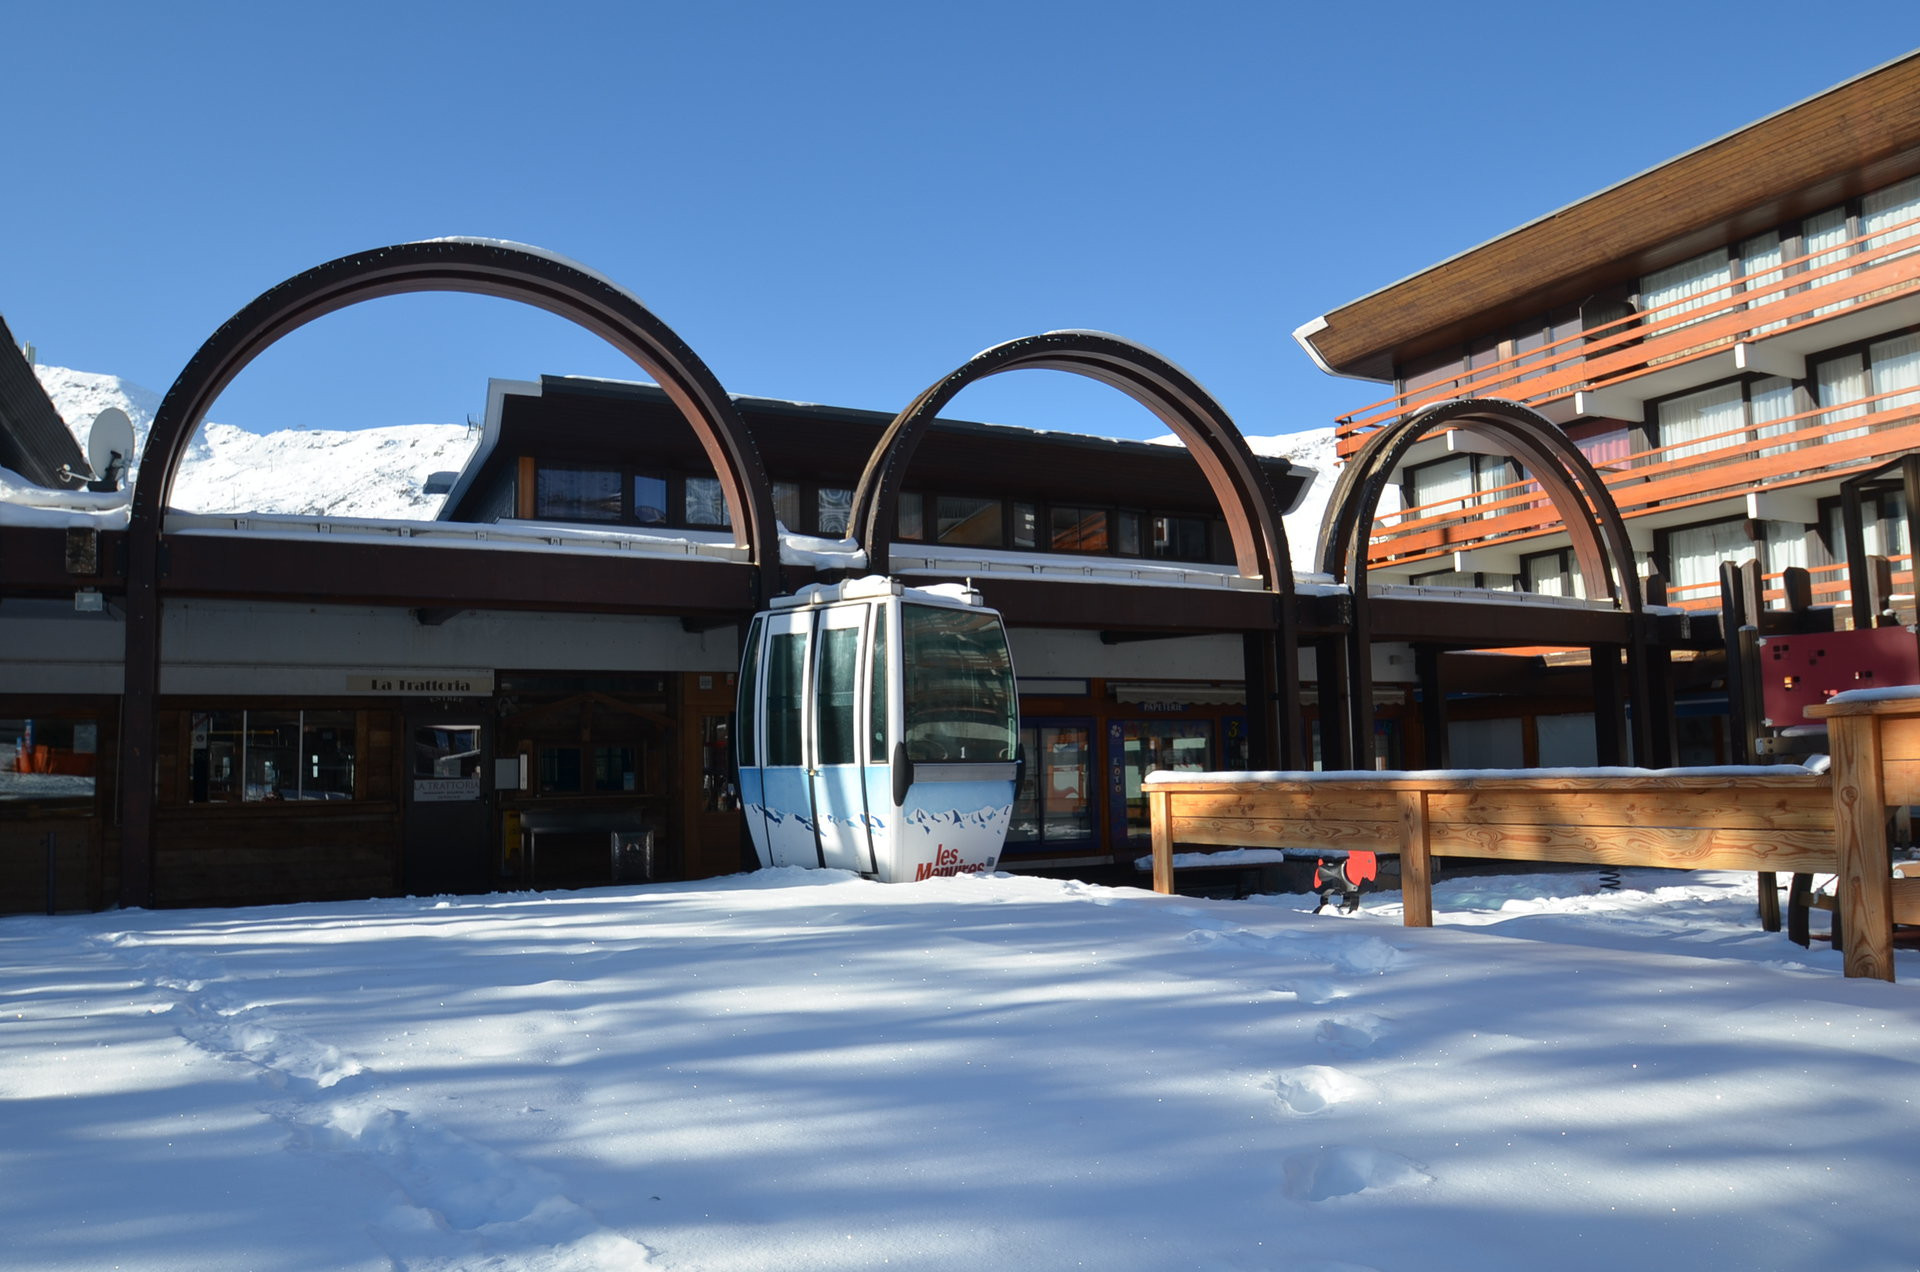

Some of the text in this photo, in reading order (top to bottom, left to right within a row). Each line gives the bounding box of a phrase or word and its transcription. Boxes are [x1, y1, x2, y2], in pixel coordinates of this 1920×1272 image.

[371, 679, 471, 691] La Trattoria
[1143, 703, 1183, 712] PAPETERIE
[1112, 757, 1122, 793] LOTO
[426, 781, 480, 791] TRATTORIA
[935, 843, 959, 867] les
